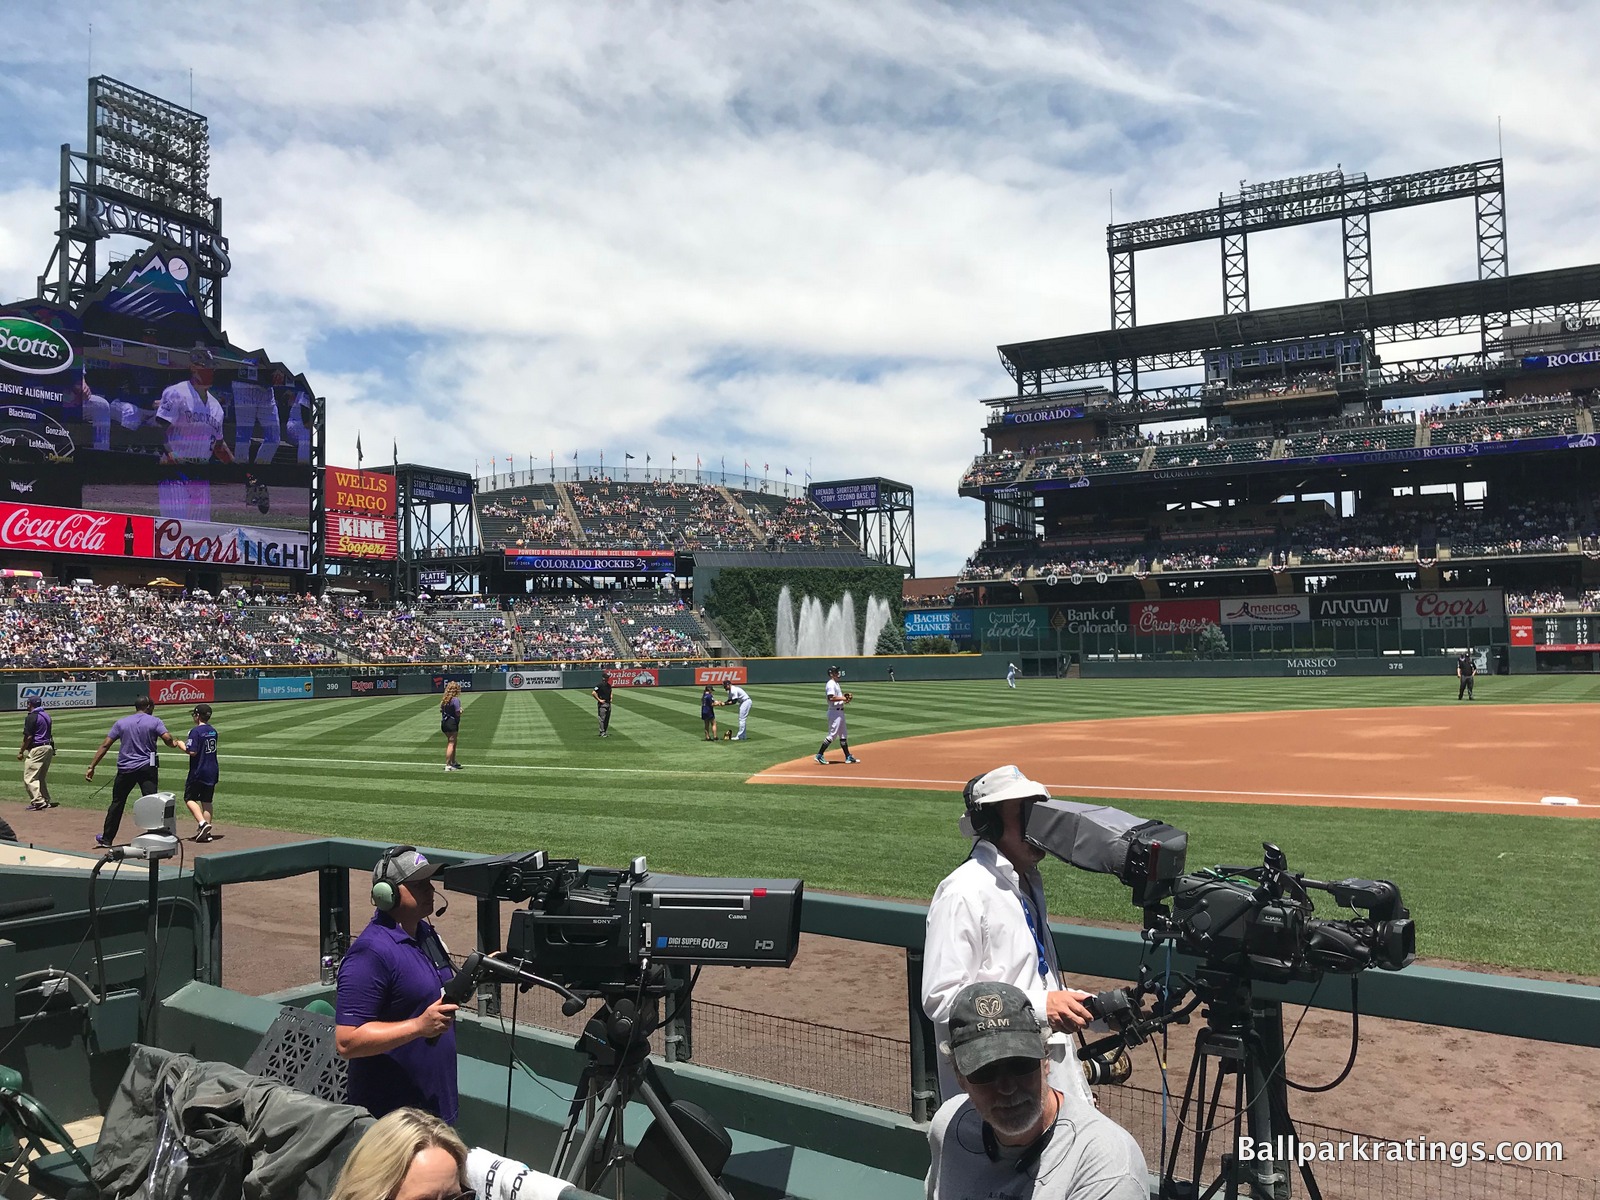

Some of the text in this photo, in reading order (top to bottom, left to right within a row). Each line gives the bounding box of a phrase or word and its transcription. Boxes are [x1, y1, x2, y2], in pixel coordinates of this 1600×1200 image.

[75, 188, 231, 278] ROCKIES
[0, 327, 60, 359] Scotts
[1258, 338, 1360, 366] ROOFTOP
[25, 387, 63, 402] ALIGNMENT
[8, 408, 36, 420] Blackmon
[1014, 408, 1071, 424] COLORADO
[45, 426, 69, 437] Gonzalez
[0, 434, 15, 446] Story
[1363, 449, 1420, 463] COLORADO
[1423, 445, 1466, 457] ROCKIES
[1468, 443, 1479, 454] 25
[10, 481, 33, 492] Wolters
[335, 472, 387, 493] WELLS
[428, 483, 445, 492] SECOND
[336, 491, 387, 511] FARGO
[837, 493, 856, 501] SECOND
[1, 508, 112, 551] Coca-Cola
[339, 517, 386, 539] KING
[155, 519, 309, 568] Coors LIGHT
[337, 536, 387, 557] Soopers
[534, 558, 647, 572] COLORADO ROCKIES 25
[420, 572, 445, 580] PLATTE
[1320, 598, 1389, 615] ARROW
[1415, 593, 1488, 616] Coors
[913, 612, 961, 623] BACHUS &
[988, 608, 1031, 624] Comfort
[1067, 606, 1115, 621] Bank of
[905, 622, 952, 632] SCHANKER
[987, 619, 1036, 637] dental
[1068, 620, 1128, 634] Colorado
[1321, 617, 1389, 627] Five Years Out
[1428, 615, 1475, 627] LIGHT
[1287, 658, 1337, 668] MARSICO
[607, 669, 637, 679] brakes
[699, 671, 741, 682] STIHL
[46, 684, 87, 692] OPTIC
[352, 680, 397, 692] Exxon Mobil
[612, 678, 630, 687] plus
[159, 686, 205, 702] Red Robin
[668, 936, 682, 944] DIGI
[681, 937, 701, 945] SUPER
[701, 937, 716, 949] 60
[754, 940, 775, 950] HD
[976, 1018, 1010, 1032] RAM
